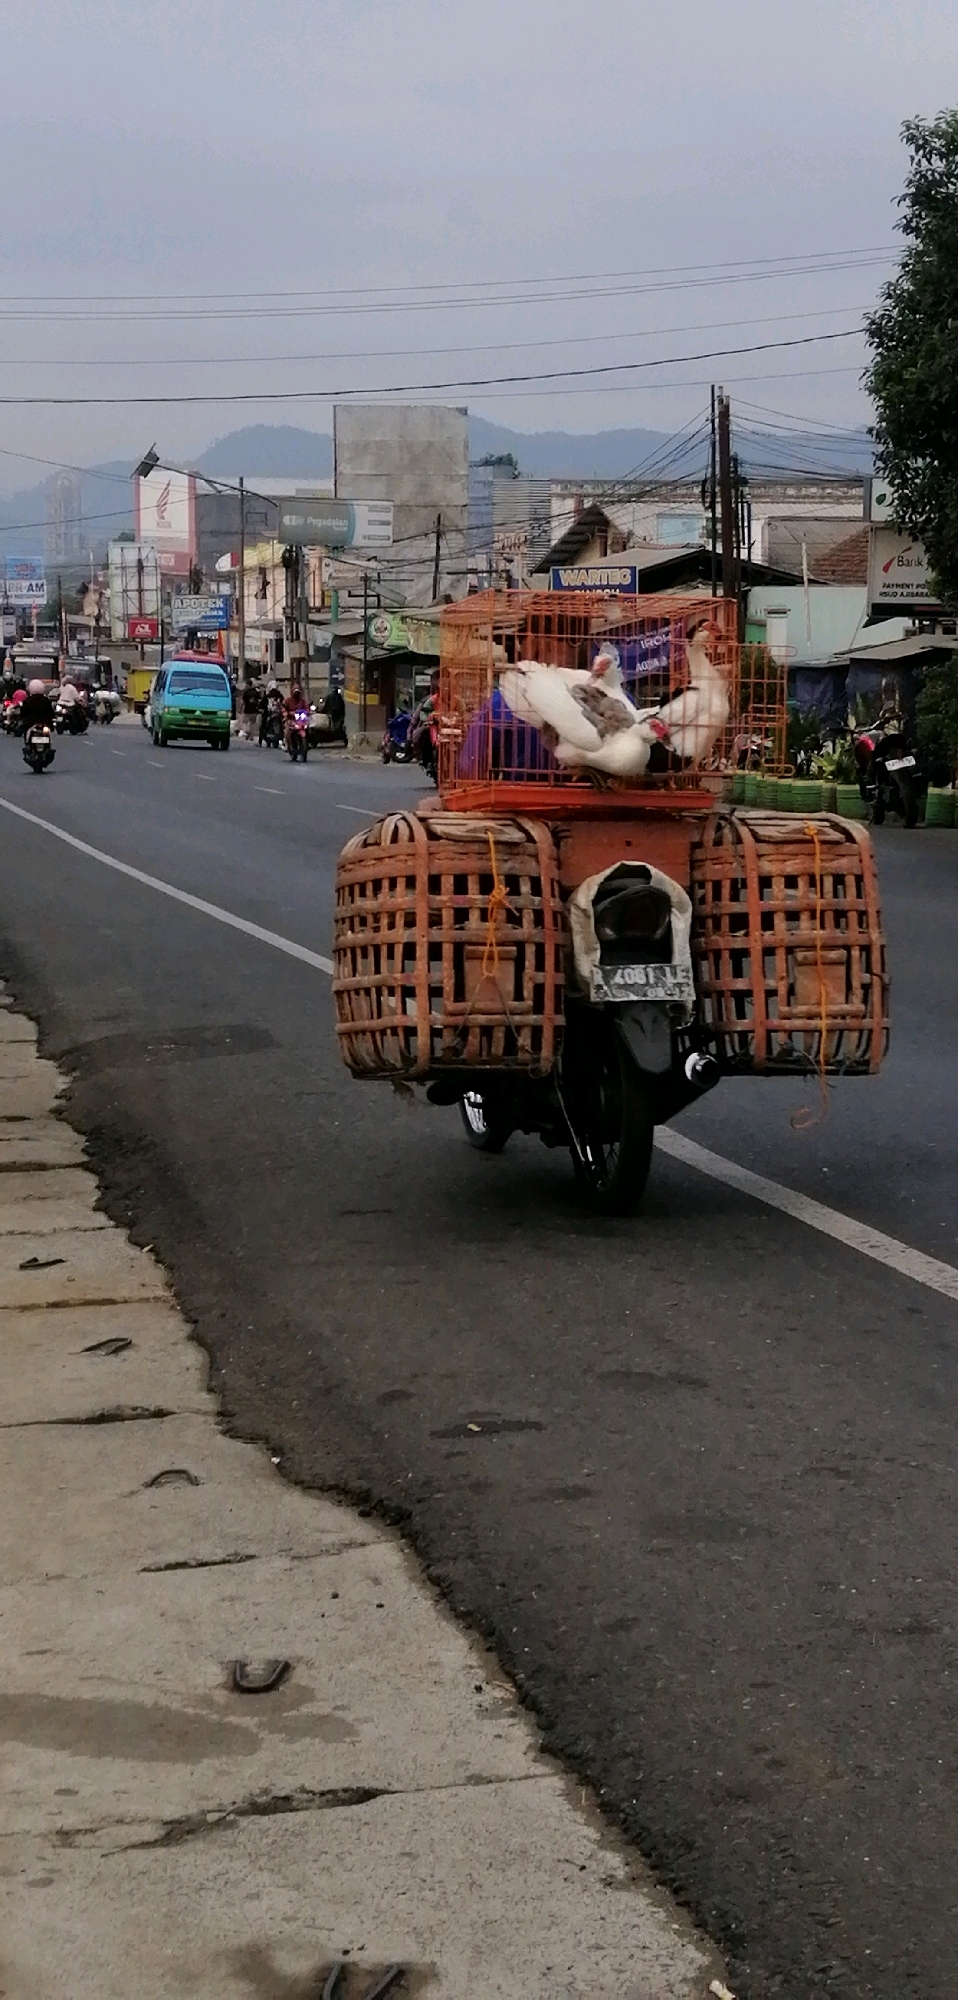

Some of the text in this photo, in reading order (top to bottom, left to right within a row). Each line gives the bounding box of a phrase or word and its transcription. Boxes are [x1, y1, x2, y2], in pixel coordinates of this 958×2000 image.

[897, 556, 923, 567] Bank
[559, 568, 631, 586] WARTEG
[173, 598, 224, 609] APOTEK
